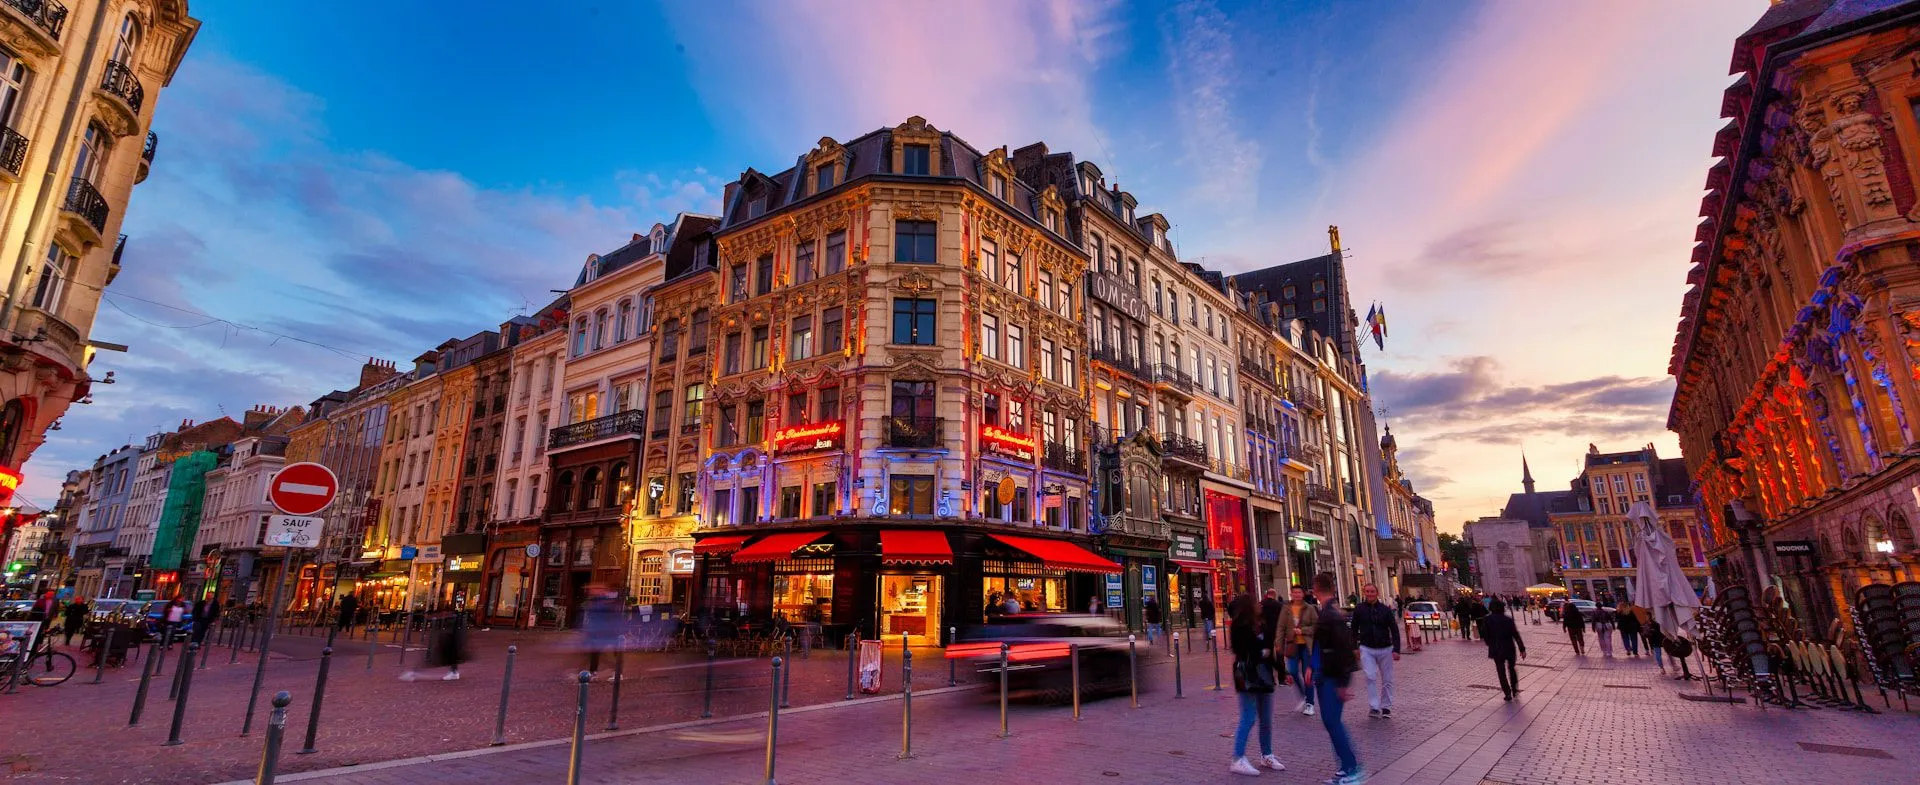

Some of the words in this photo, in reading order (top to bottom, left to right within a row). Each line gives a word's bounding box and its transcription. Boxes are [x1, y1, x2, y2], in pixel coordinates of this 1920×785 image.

[1097, 276, 1147, 323] OMEGA
[814, 439, 832, 449] Jean
[1016, 448, 1031, 460] Jean
[282, 518, 312, 527] SAUF
